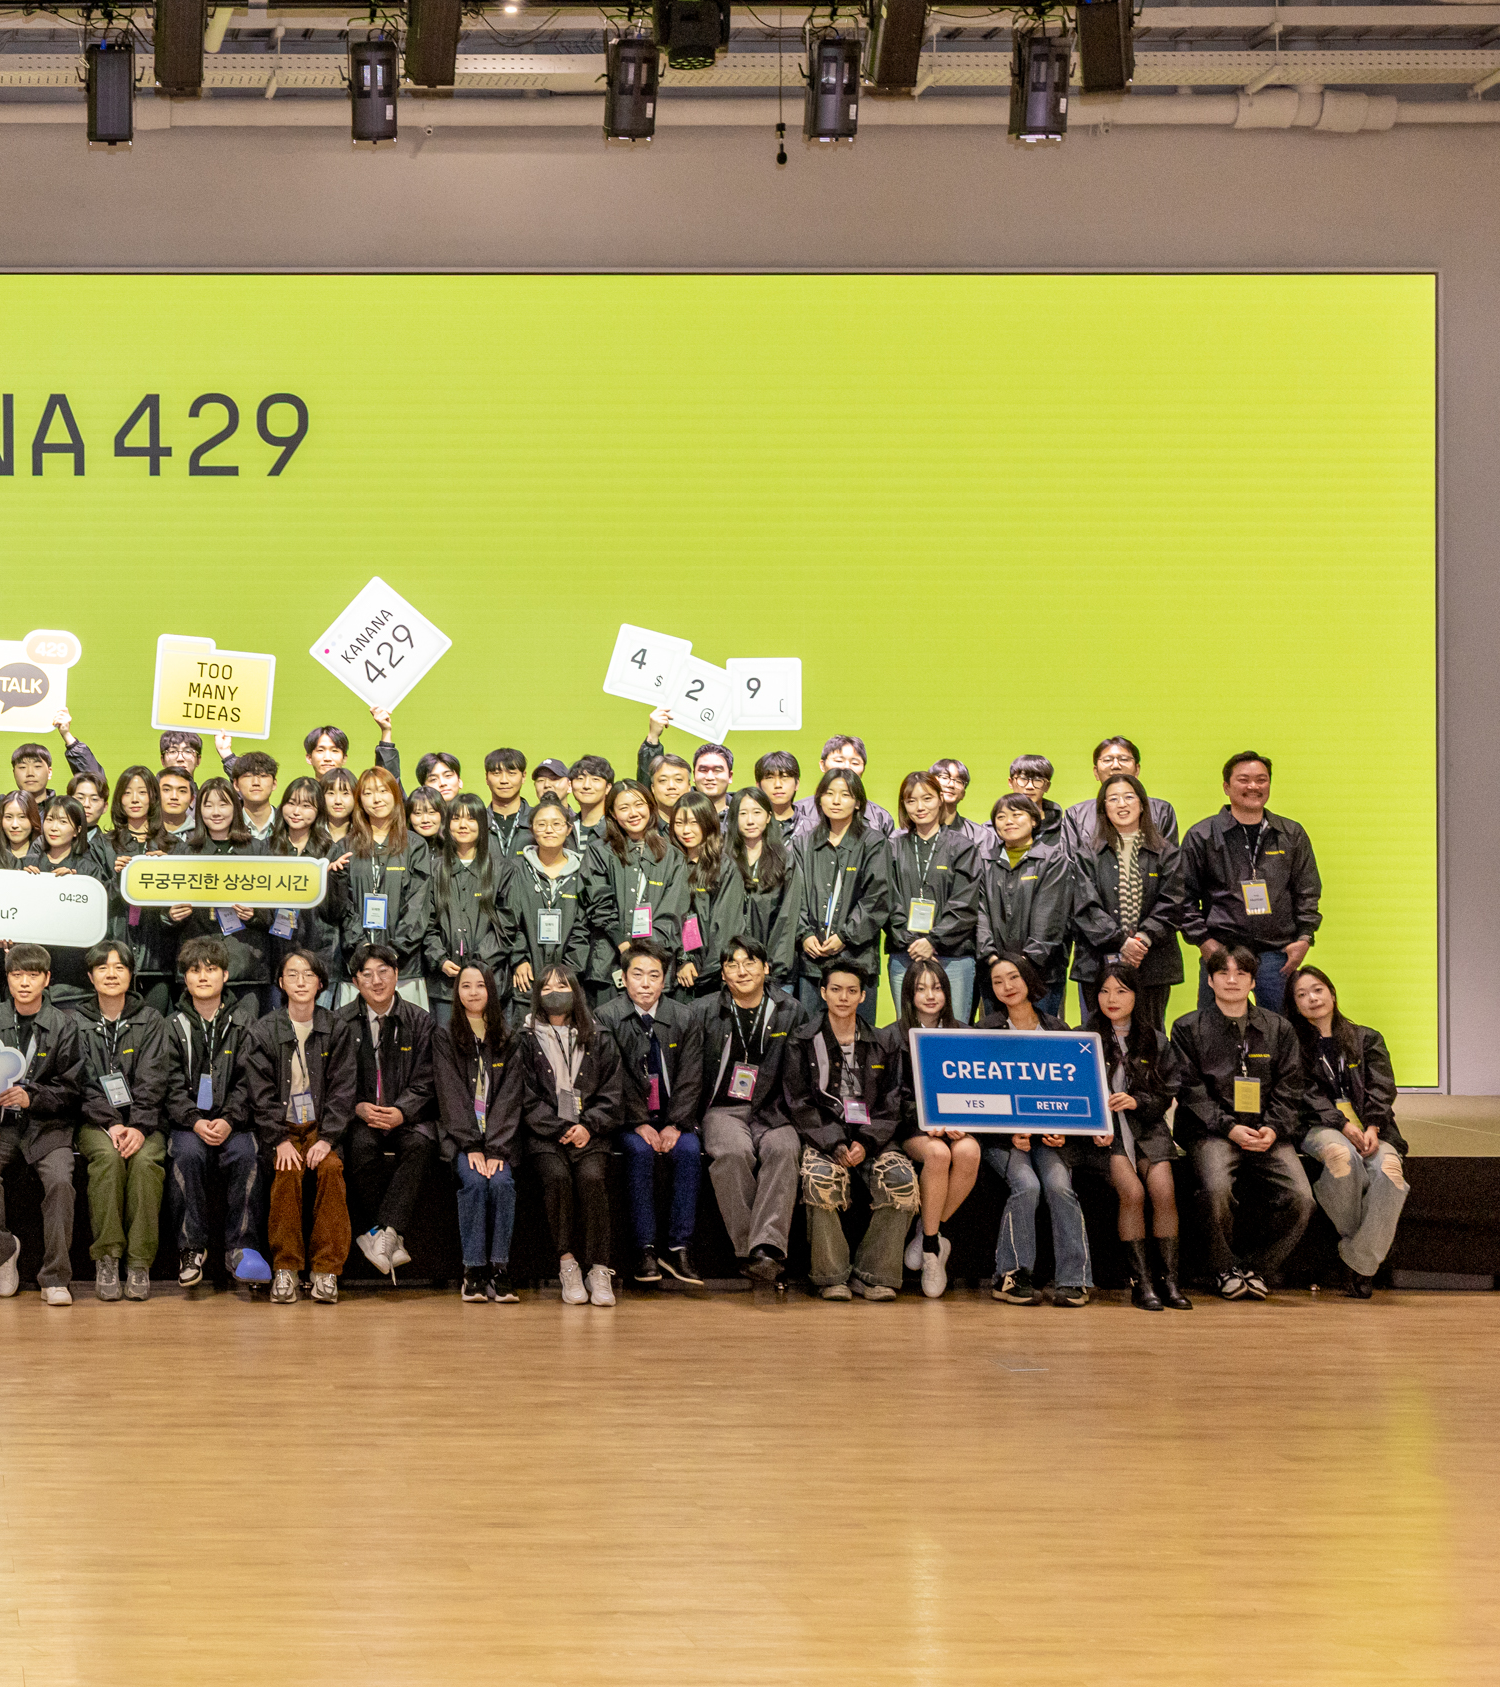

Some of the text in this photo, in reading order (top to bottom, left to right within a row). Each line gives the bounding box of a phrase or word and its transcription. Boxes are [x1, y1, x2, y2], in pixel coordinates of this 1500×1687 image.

[113, 392, 310, 477] 429
[340, 609, 394, 664] KANANA
[34, 641, 69, 658] 429
[364, 624, 414, 683] 429
[196, 661, 233, 680] TOO
[630, 648, 762, 702] 4 2 9
[188, 682, 239, 702] MANY
[182, 702, 242, 723] IDEAS
[699, 707, 715, 722] @
[138, 872, 310, 892] 무궁무진한 상상의 시간
[58, 892, 89, 904] 04:29
[941, 1060, 1077, 1082] CREATIVE?
[965, 1099, 985, 1109] YES
[1036, 1100, 1070, 1111] RETRY
